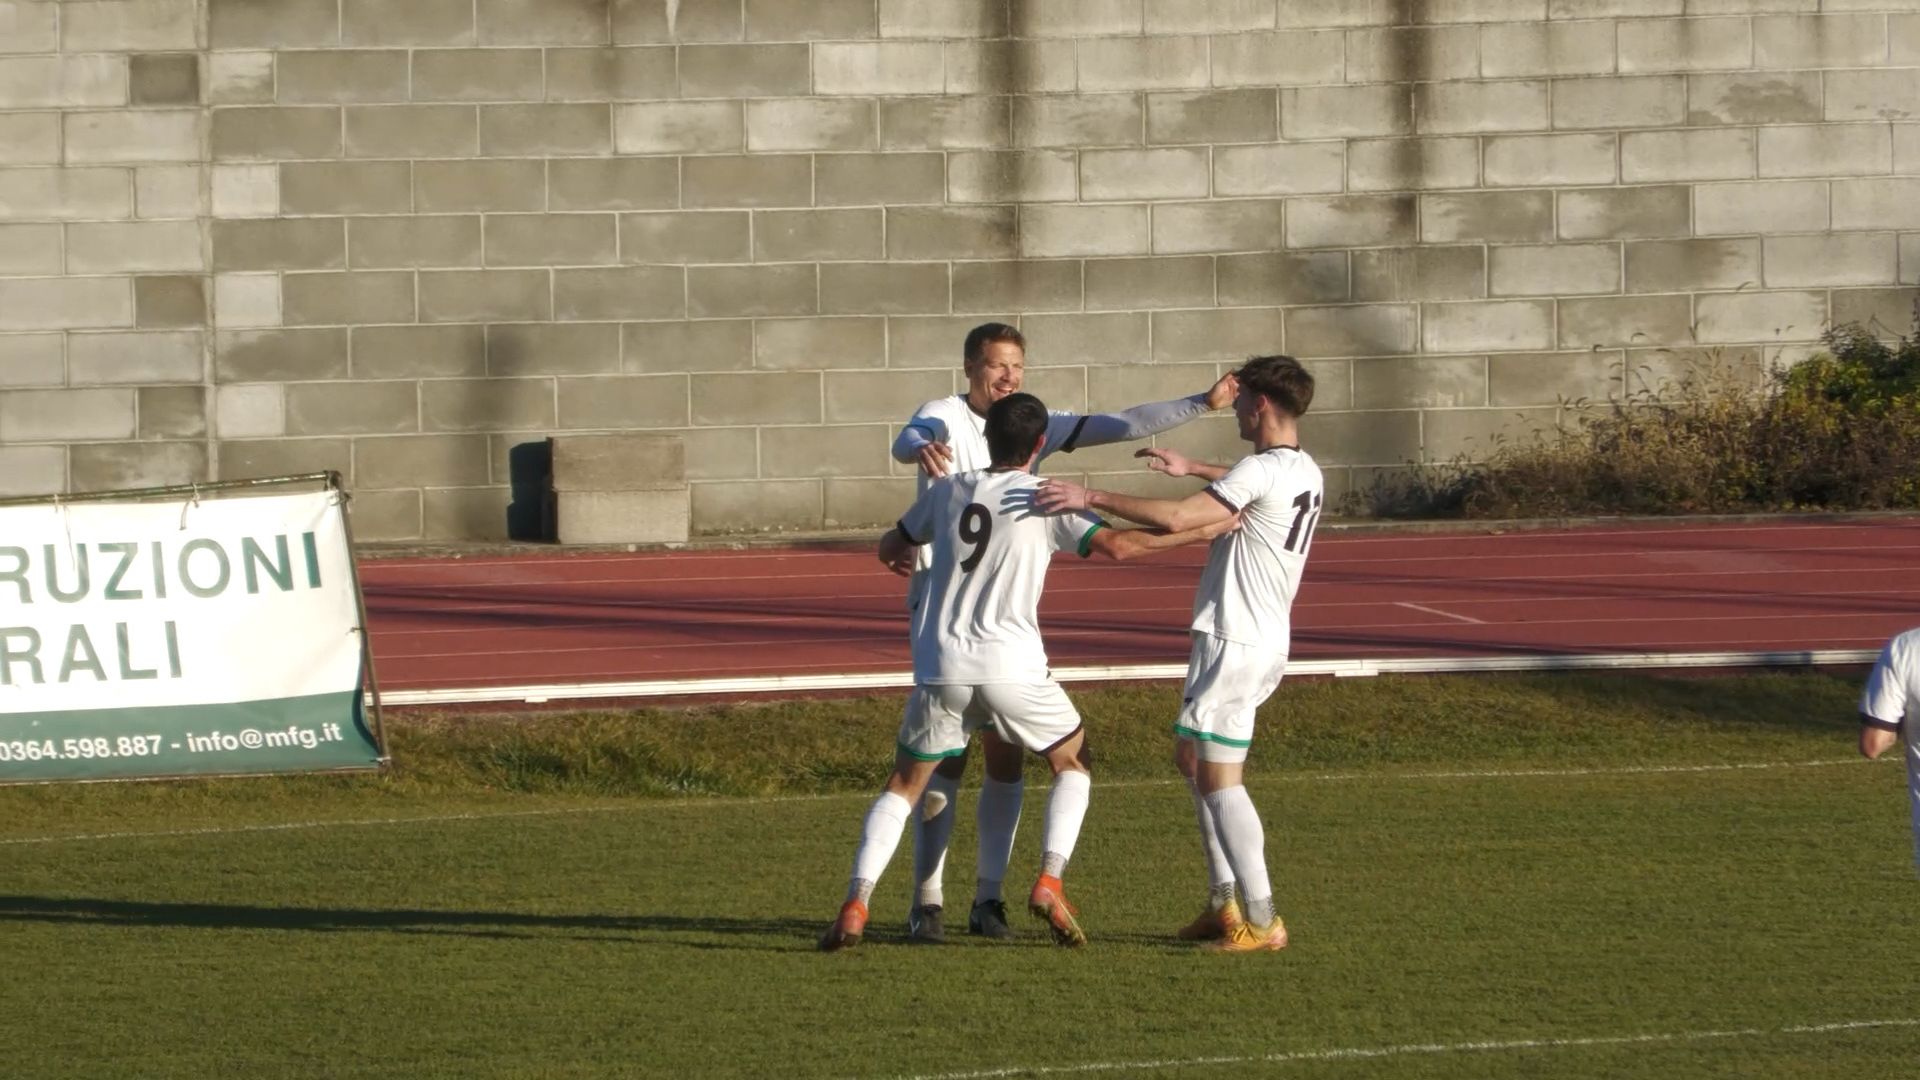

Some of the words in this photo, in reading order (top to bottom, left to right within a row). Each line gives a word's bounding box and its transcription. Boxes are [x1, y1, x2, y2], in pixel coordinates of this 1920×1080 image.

[959, 503, 992, 573] 9
[0, 620, 182, 686] RALI
[0, 735, 162, 761] 0364.598.887
[187, 722, 343, 753] info@mfg.it
